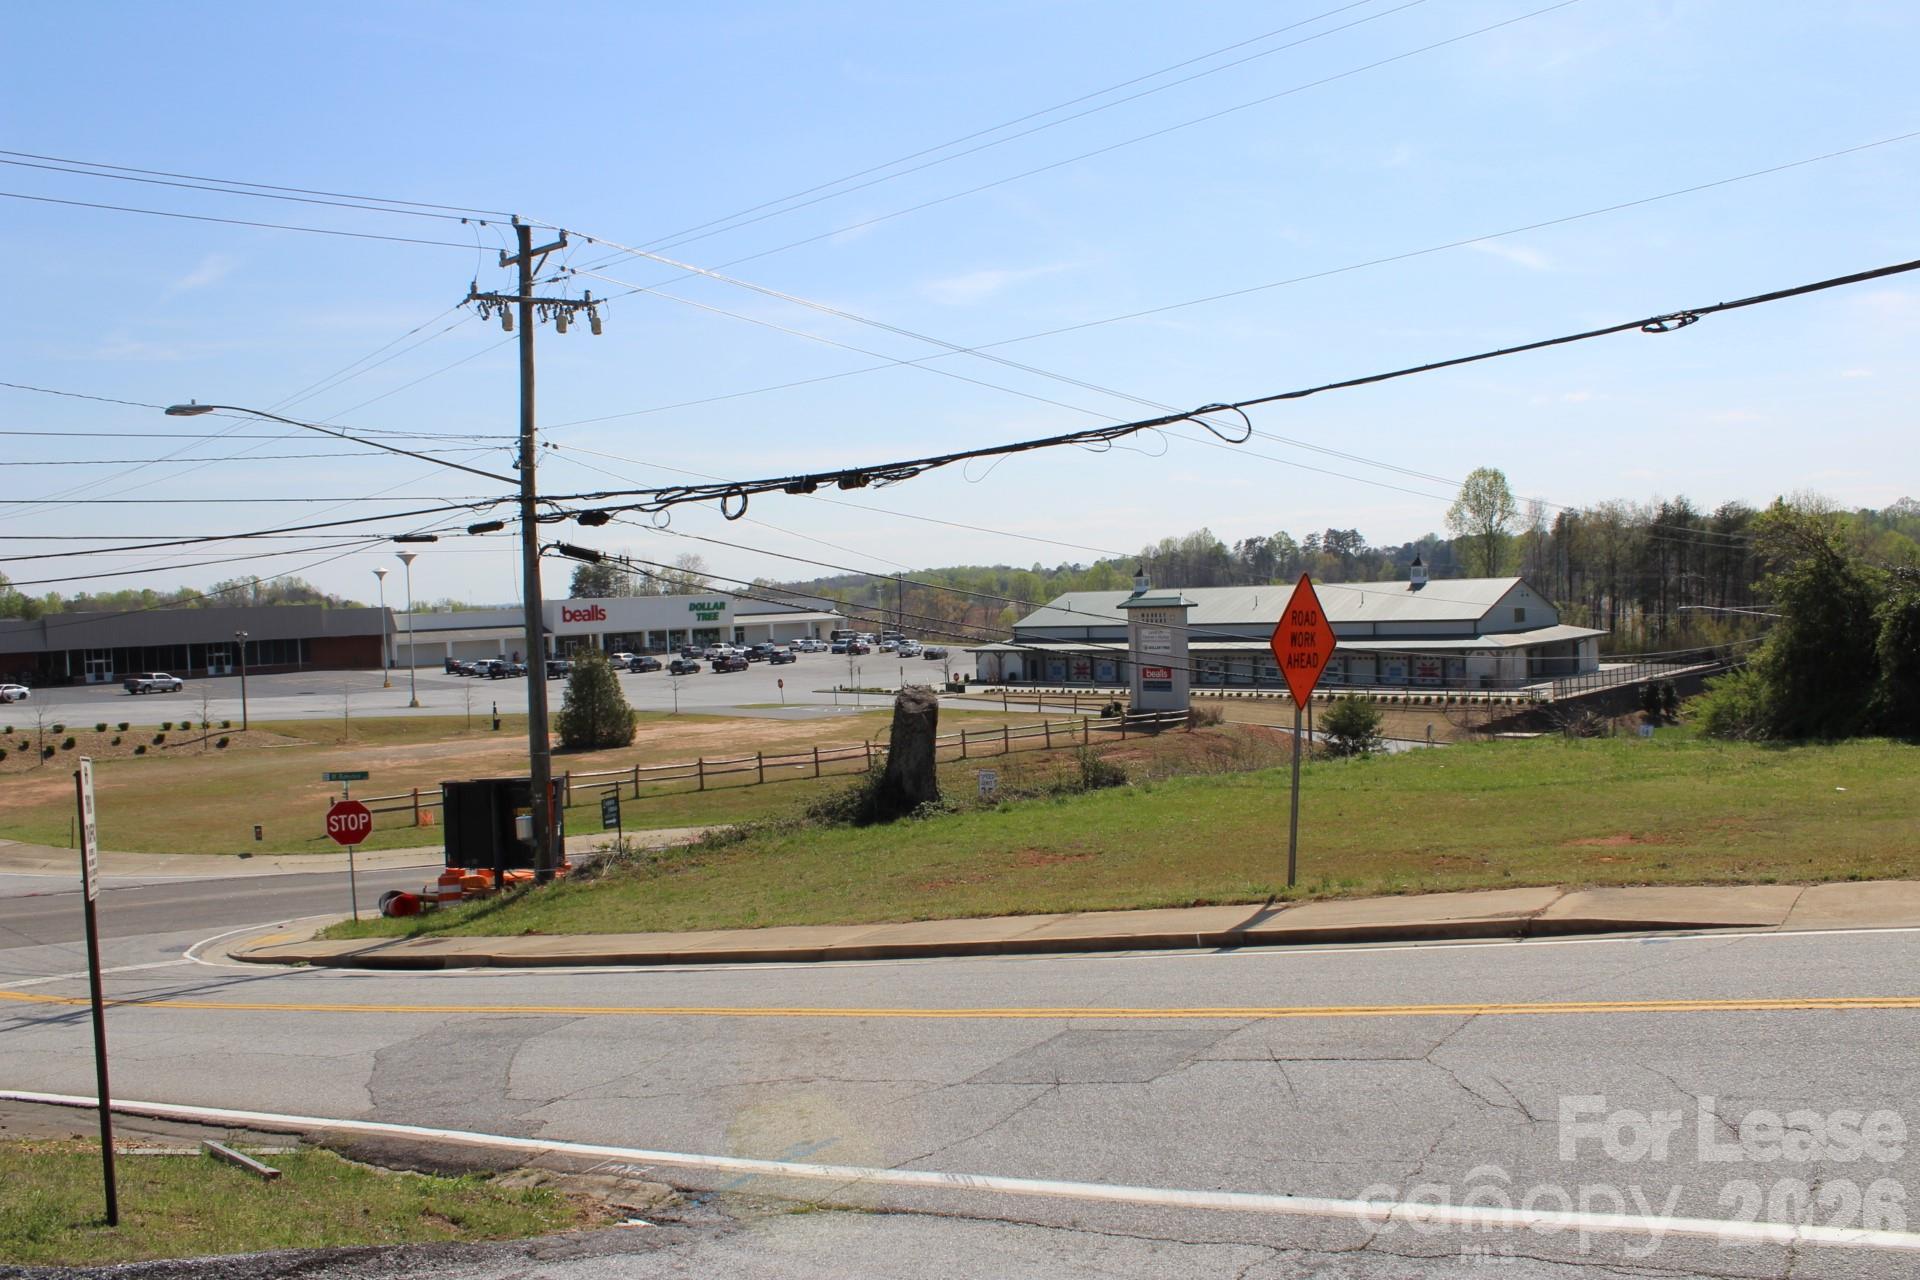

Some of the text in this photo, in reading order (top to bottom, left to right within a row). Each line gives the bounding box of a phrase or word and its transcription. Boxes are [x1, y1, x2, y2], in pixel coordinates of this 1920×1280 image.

[562, 604, 607, 623] bealls
[689, 601, 726, 611] DOLLAR
[696, 612, 720, 622] TREE
[1291, 610, 1317, 626] ROAD
[1290, 631, 1317, 648] WORK
[1286, 652, 1319, 670] AHEAD
[1146, 668, 1168, 678] bealls
[329, 813, 369, 832] STOP
